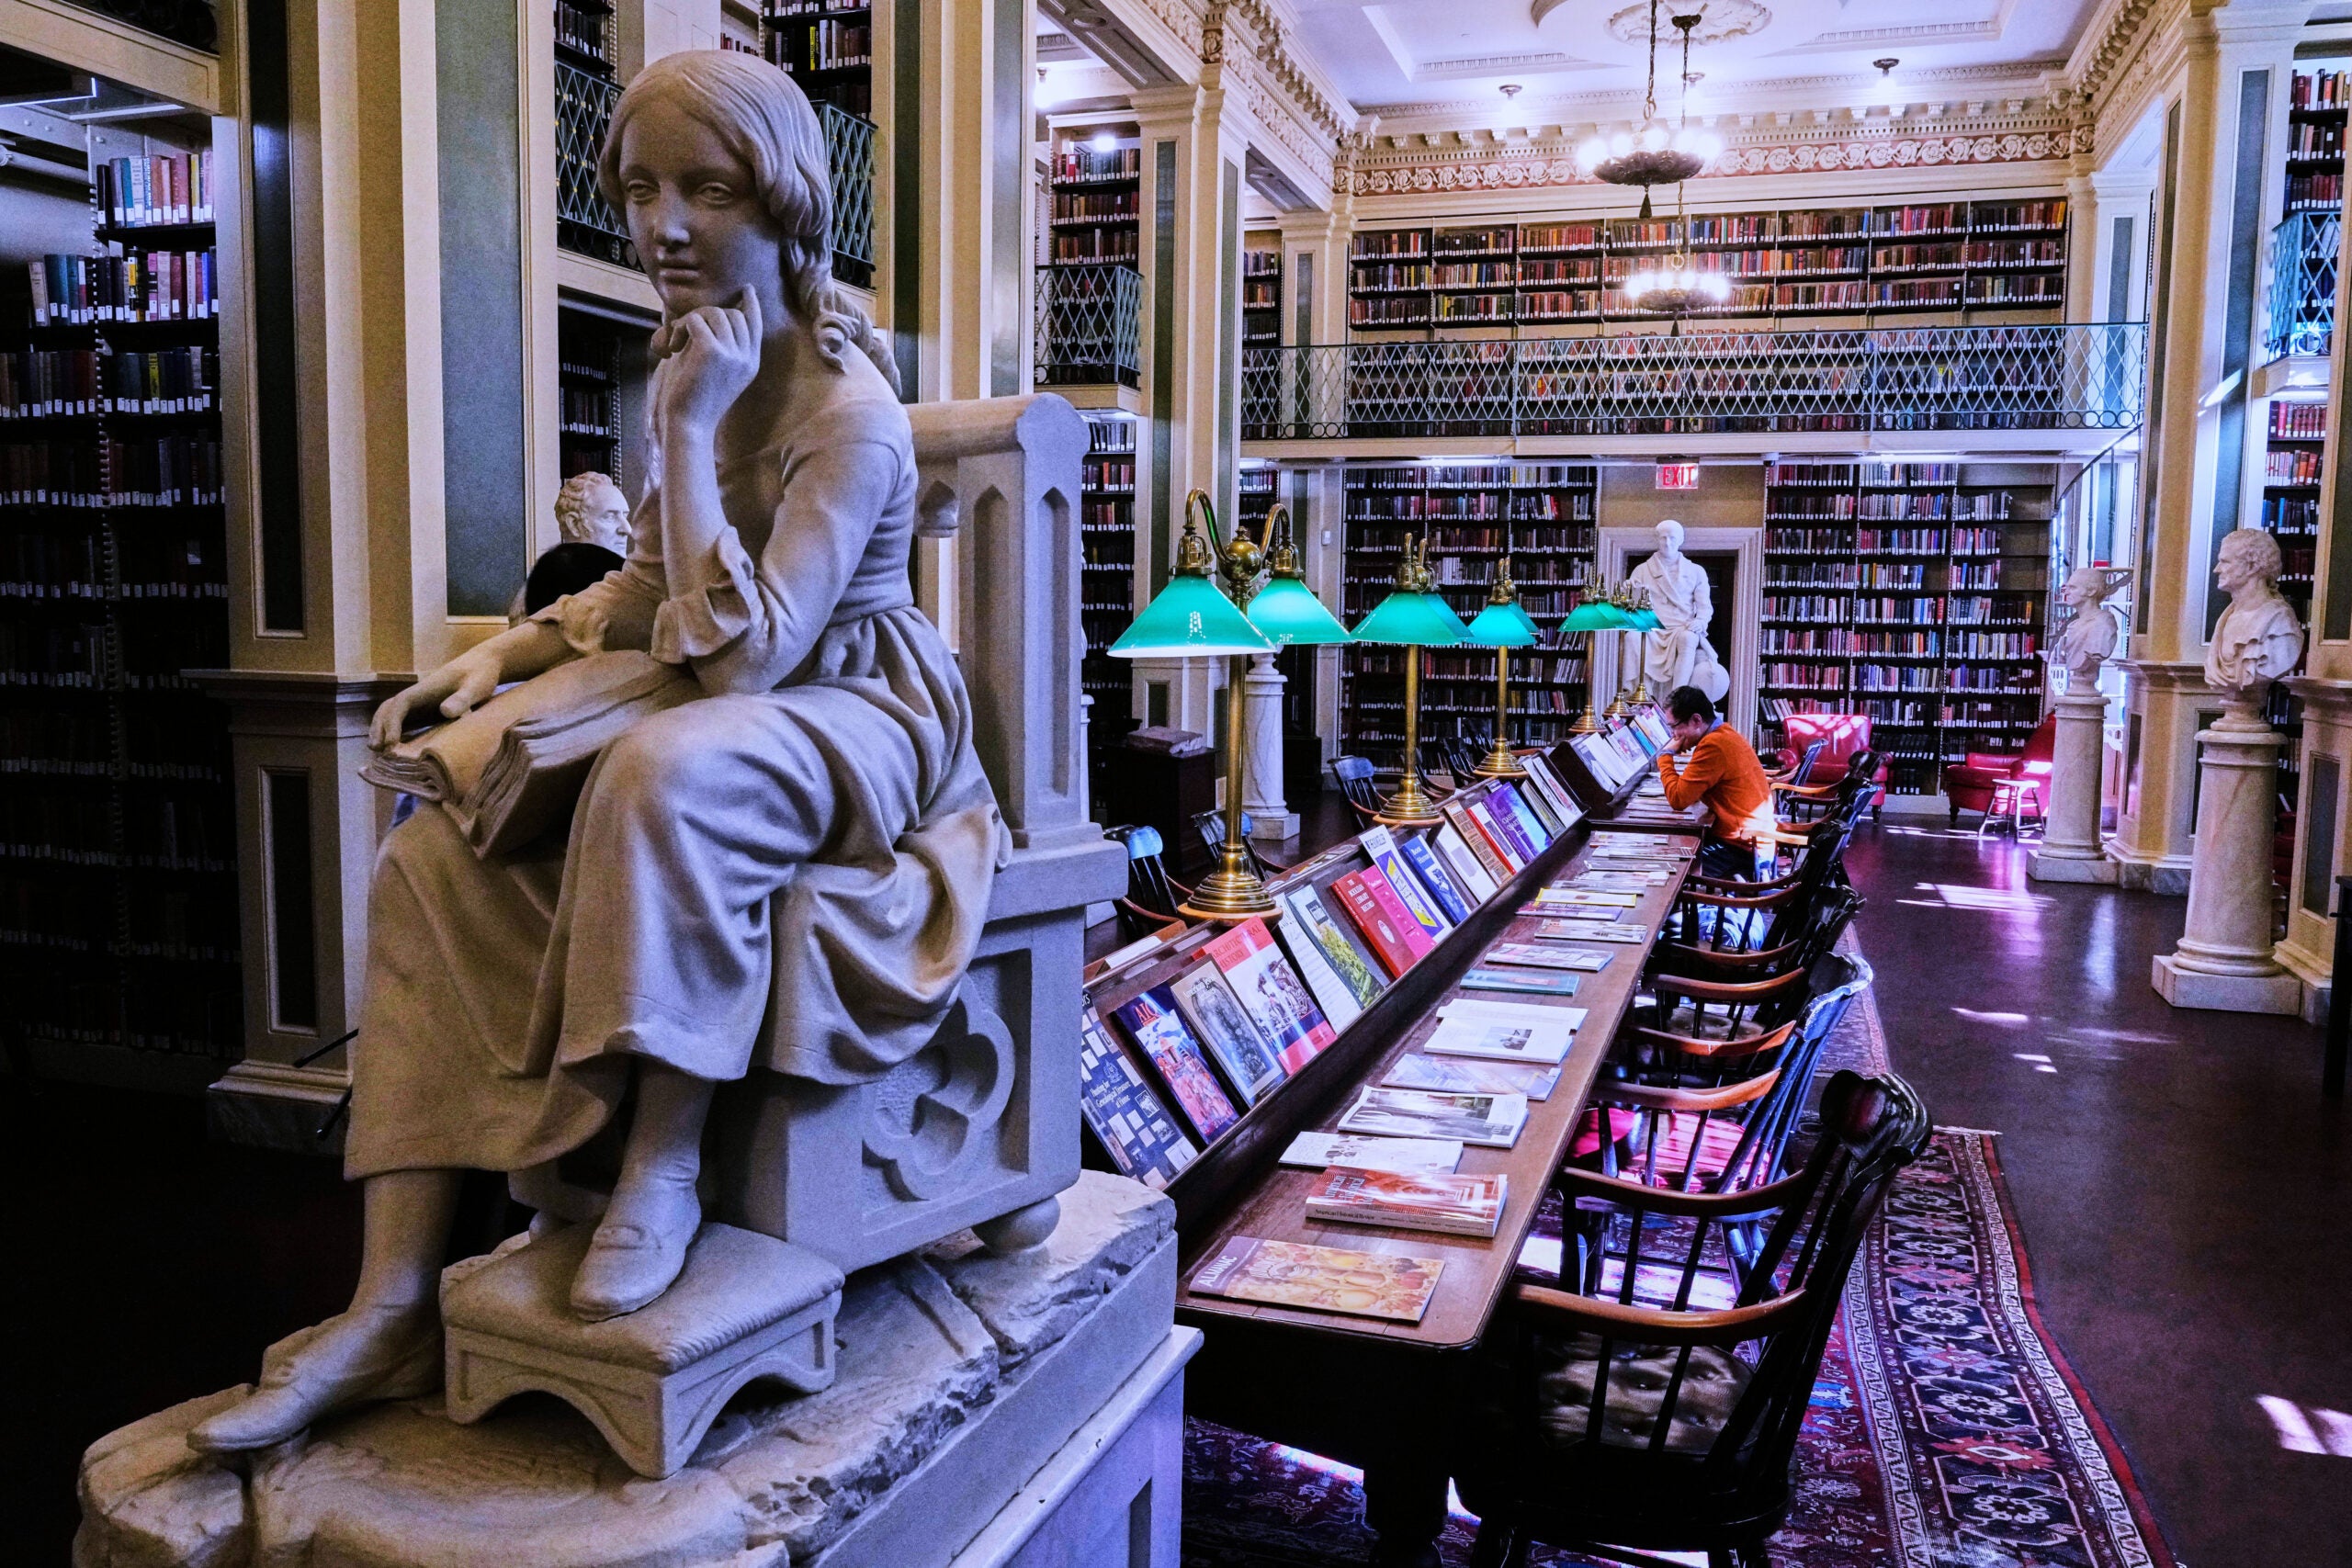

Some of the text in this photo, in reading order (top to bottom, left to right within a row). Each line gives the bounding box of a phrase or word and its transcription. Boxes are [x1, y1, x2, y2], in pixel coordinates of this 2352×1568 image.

[1663, 466, 1695, 486] EXIT
[1336, 1211, 1359, 1219] Historical
[1198, 1256, 1238, 1287] ALMANAC
